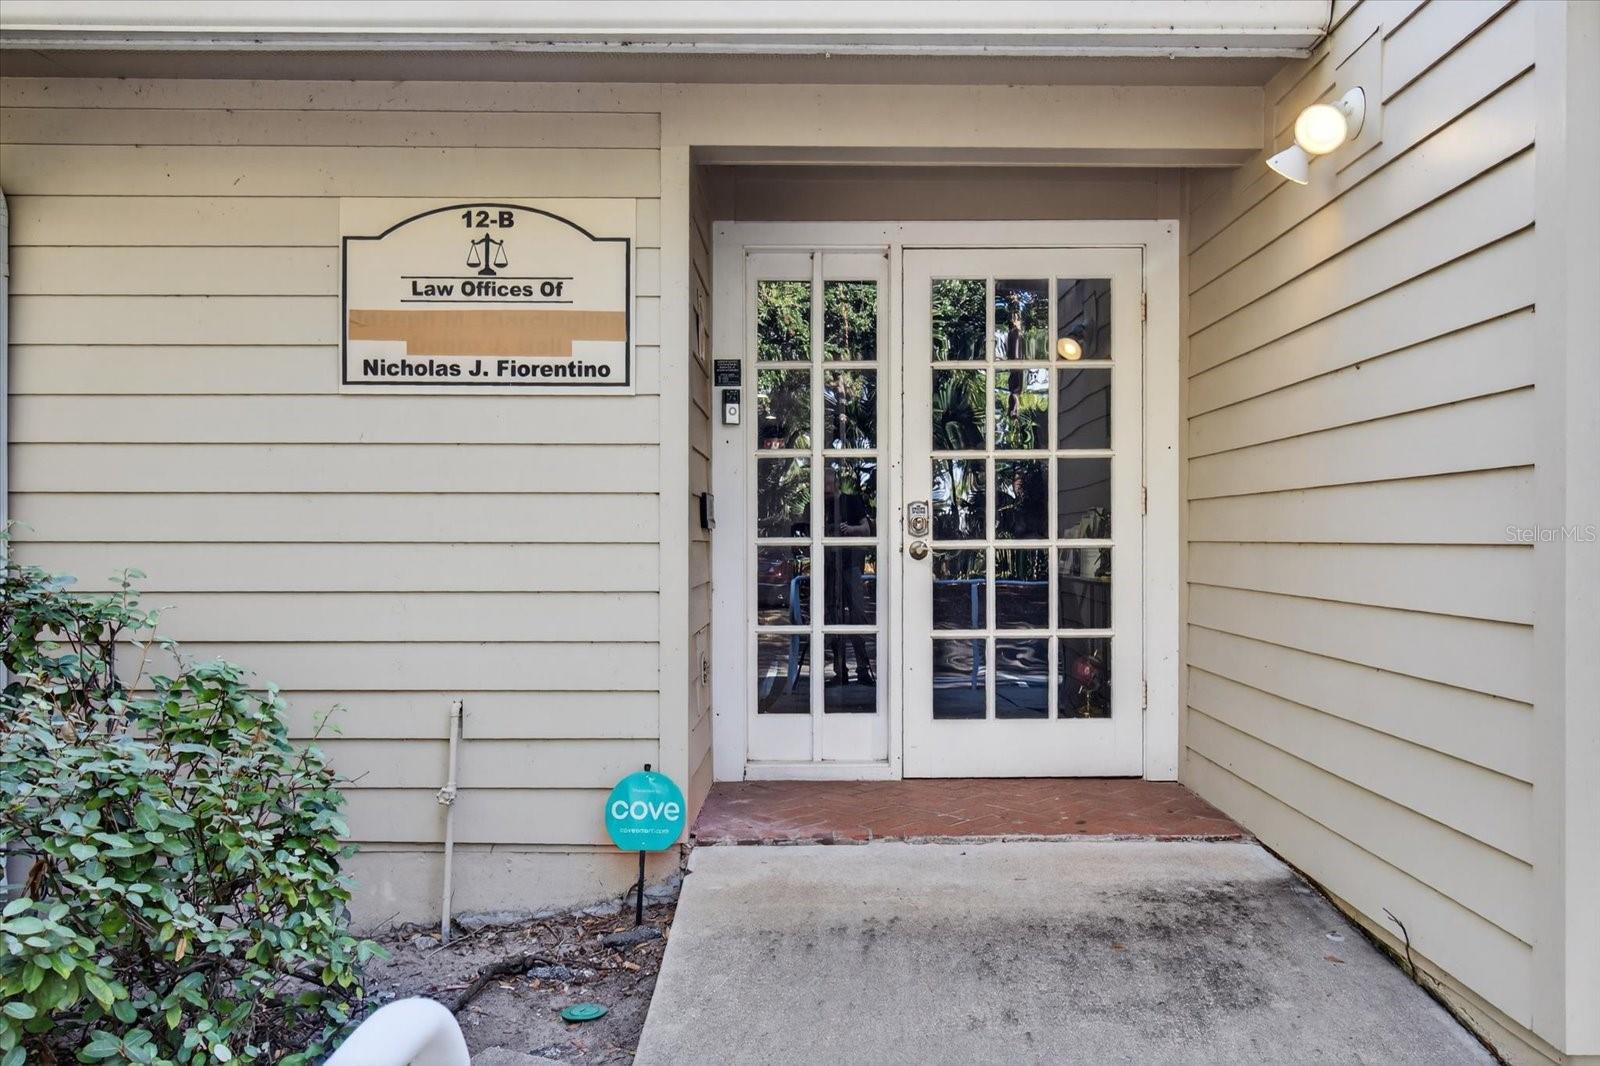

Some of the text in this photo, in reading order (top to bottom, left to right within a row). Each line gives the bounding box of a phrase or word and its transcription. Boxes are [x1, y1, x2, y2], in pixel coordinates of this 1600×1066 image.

[461, 210, 515, 229] 12-B
[411, 280, 564, 298] Law Offices Of
[362, 358, 611, 378] Nicholas J. Fiorentino
[611, 800, 680, 821] cove
